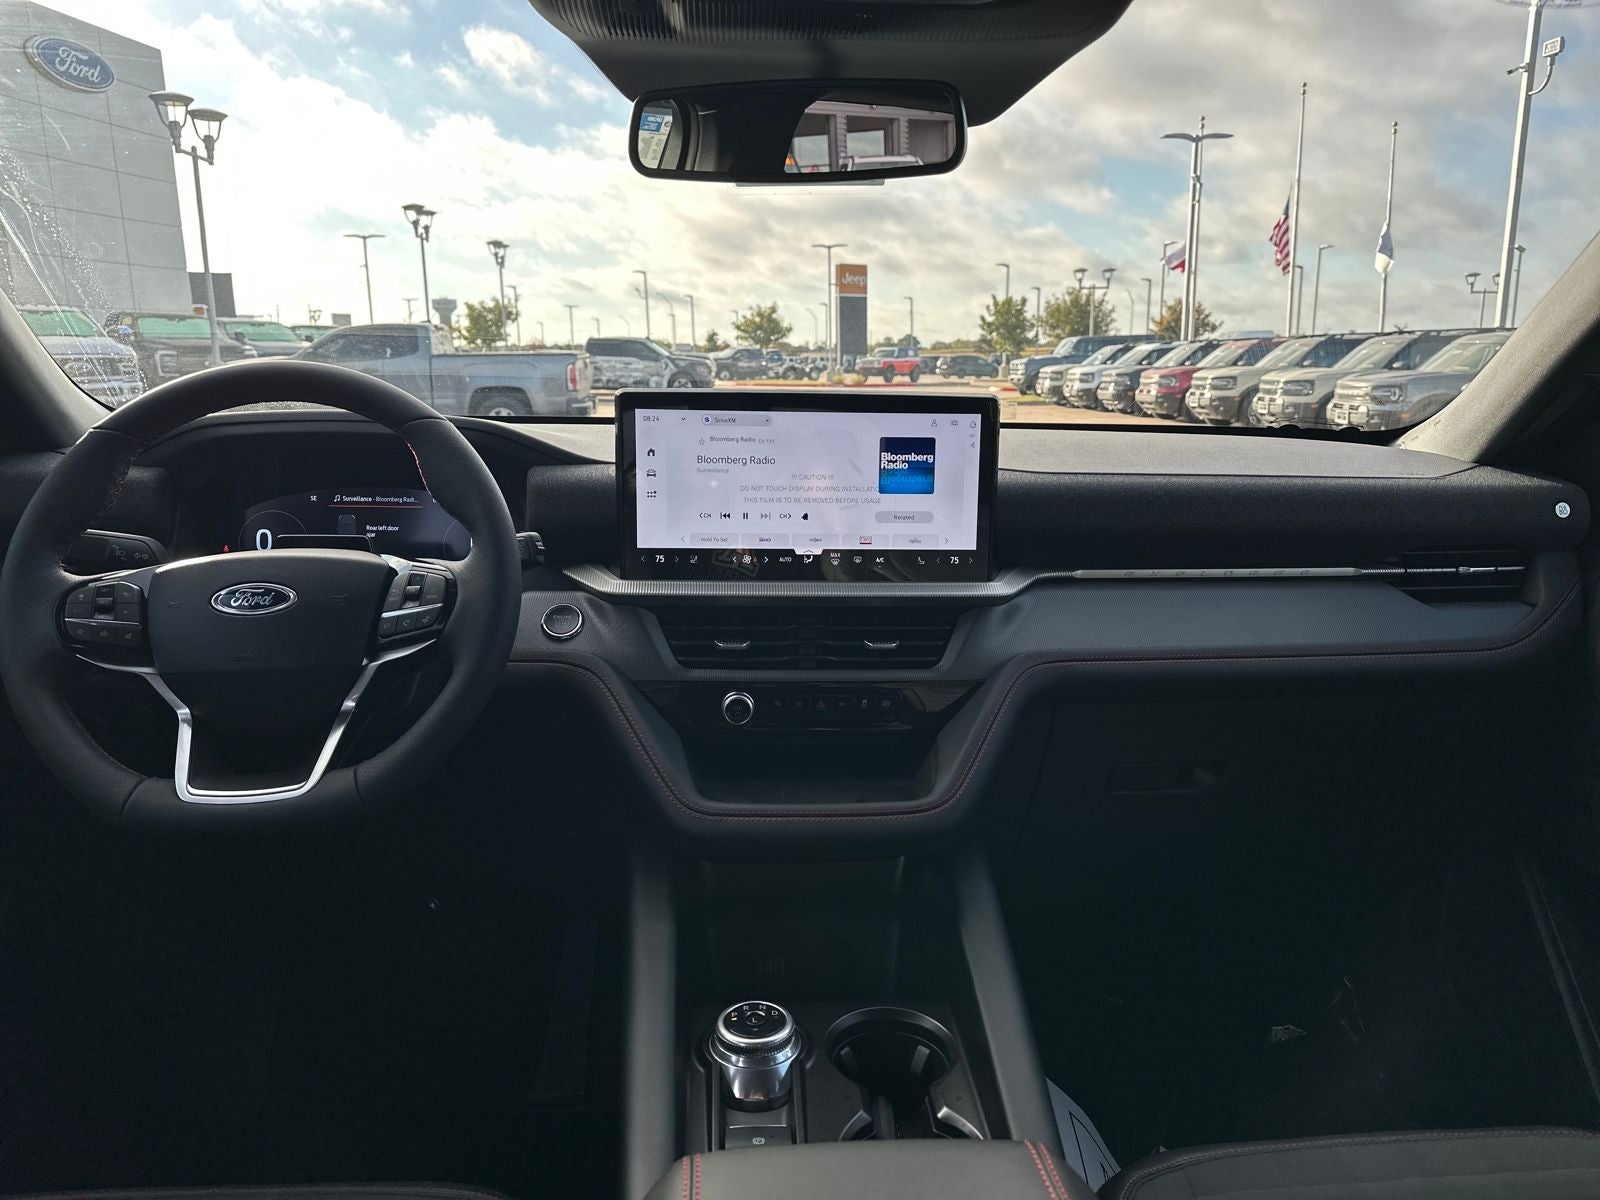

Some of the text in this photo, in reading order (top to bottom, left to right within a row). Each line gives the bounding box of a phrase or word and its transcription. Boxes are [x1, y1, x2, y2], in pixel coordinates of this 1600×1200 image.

[54, 45, 101, 83] Ford
[841, 271, 866, 287] Jeep
[709, 435, 740, 443] Bloomberg
[697, 455, 776, 467] Bloomberg Radio
[881, 452, 934, 463] Bloomberg
[881, 460, 909, 469] Radio
[375, 496, 402, 504] Bloomberg
[255, 528, 273, 551] 0
[655, 555, 665, 563] 75
[950, 556, 960, 564] 75
[230, 588, 275, 607] Ford
